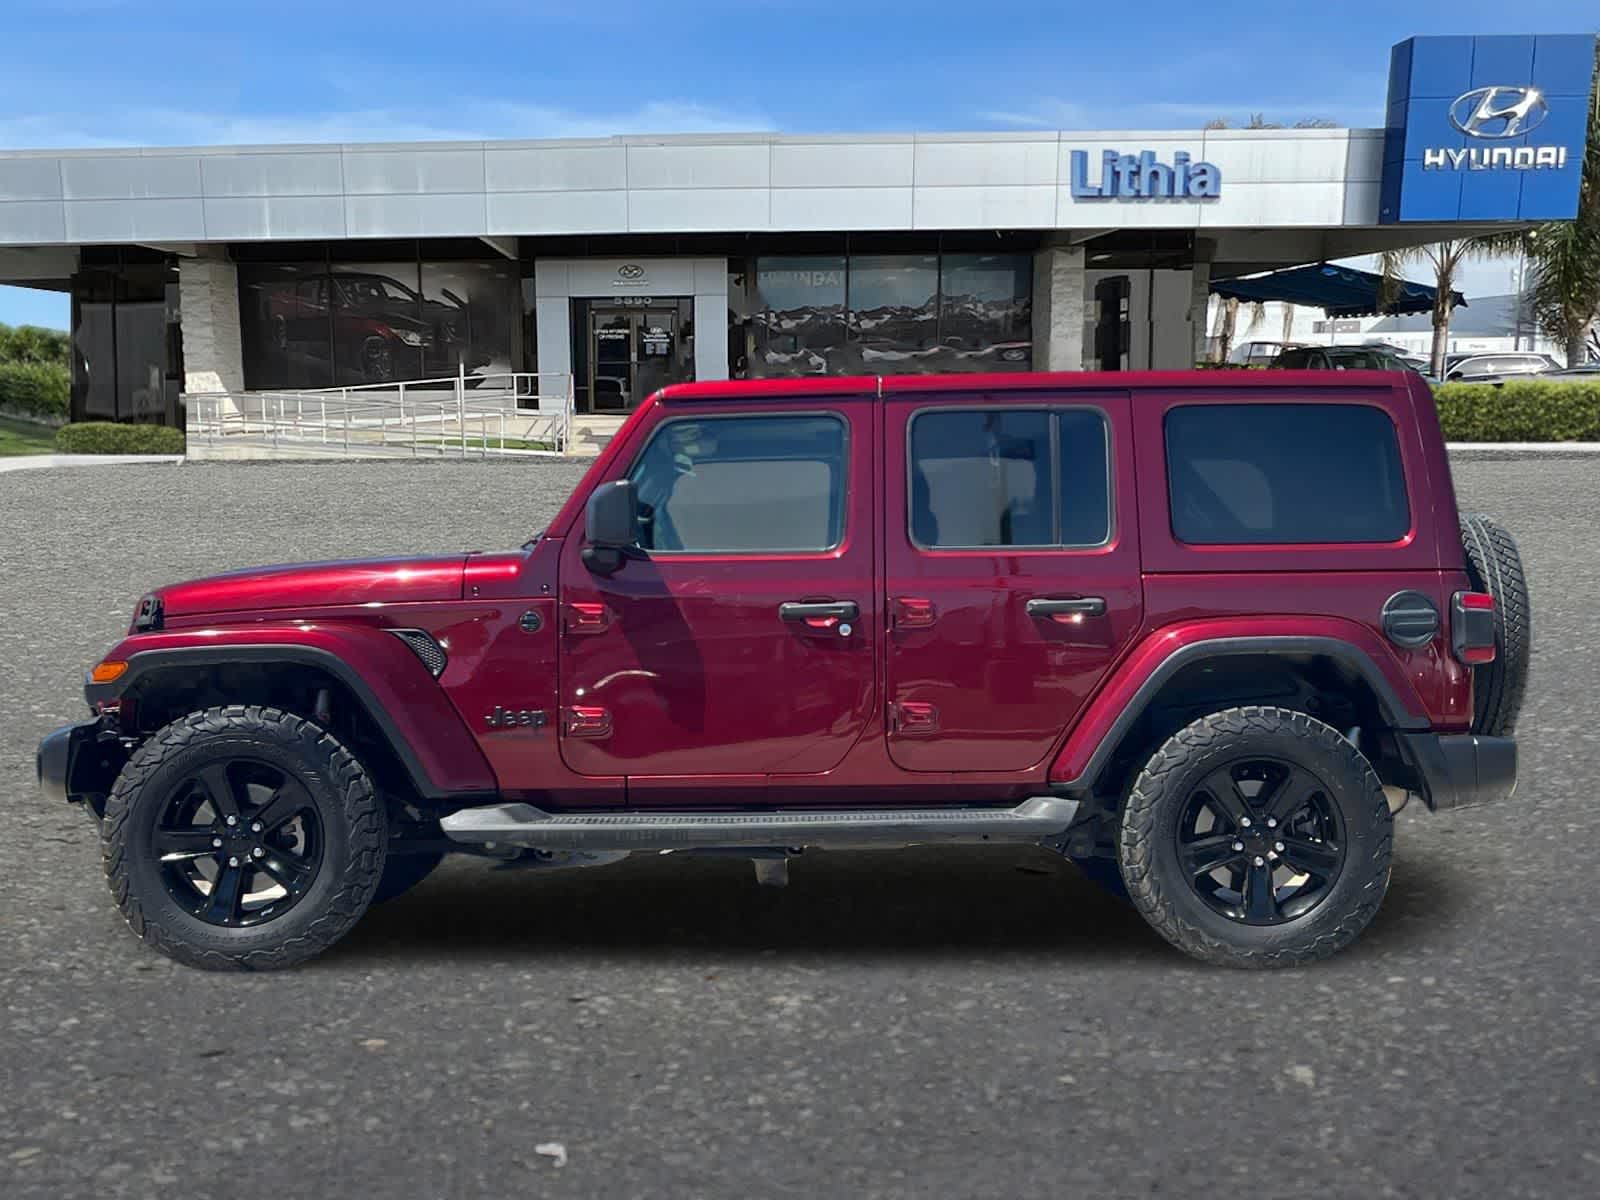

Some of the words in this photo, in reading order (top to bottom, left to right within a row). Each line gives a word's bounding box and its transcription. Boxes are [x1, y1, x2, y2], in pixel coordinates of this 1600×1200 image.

[1423, 146, 1567, 170] HYUNDAI
[1071, 150, 1221, 199] Lithia
[485, 705, 546, 730] Jeep
